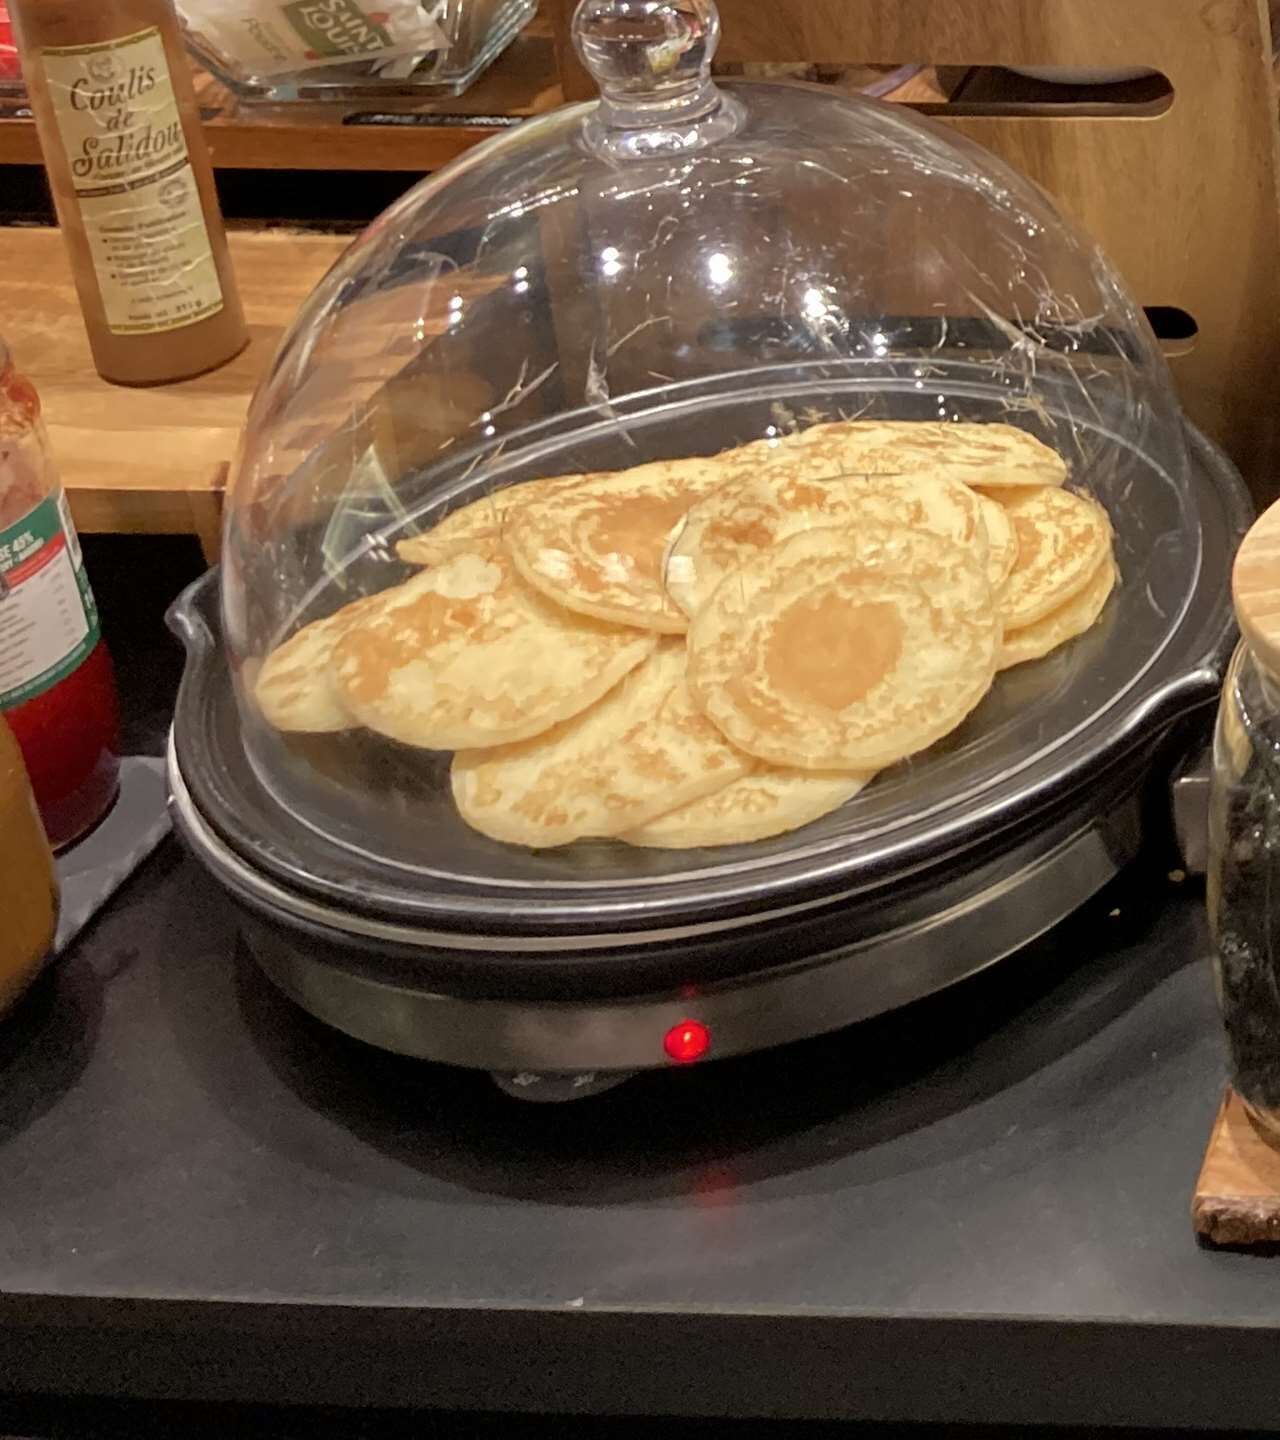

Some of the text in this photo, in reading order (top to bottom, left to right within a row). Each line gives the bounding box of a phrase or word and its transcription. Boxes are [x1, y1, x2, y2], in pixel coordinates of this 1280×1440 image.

[70, 65, 155, 111] Coulis
[105, 108, 134, 131] de
[72, 122, 181, 177] Salidou
